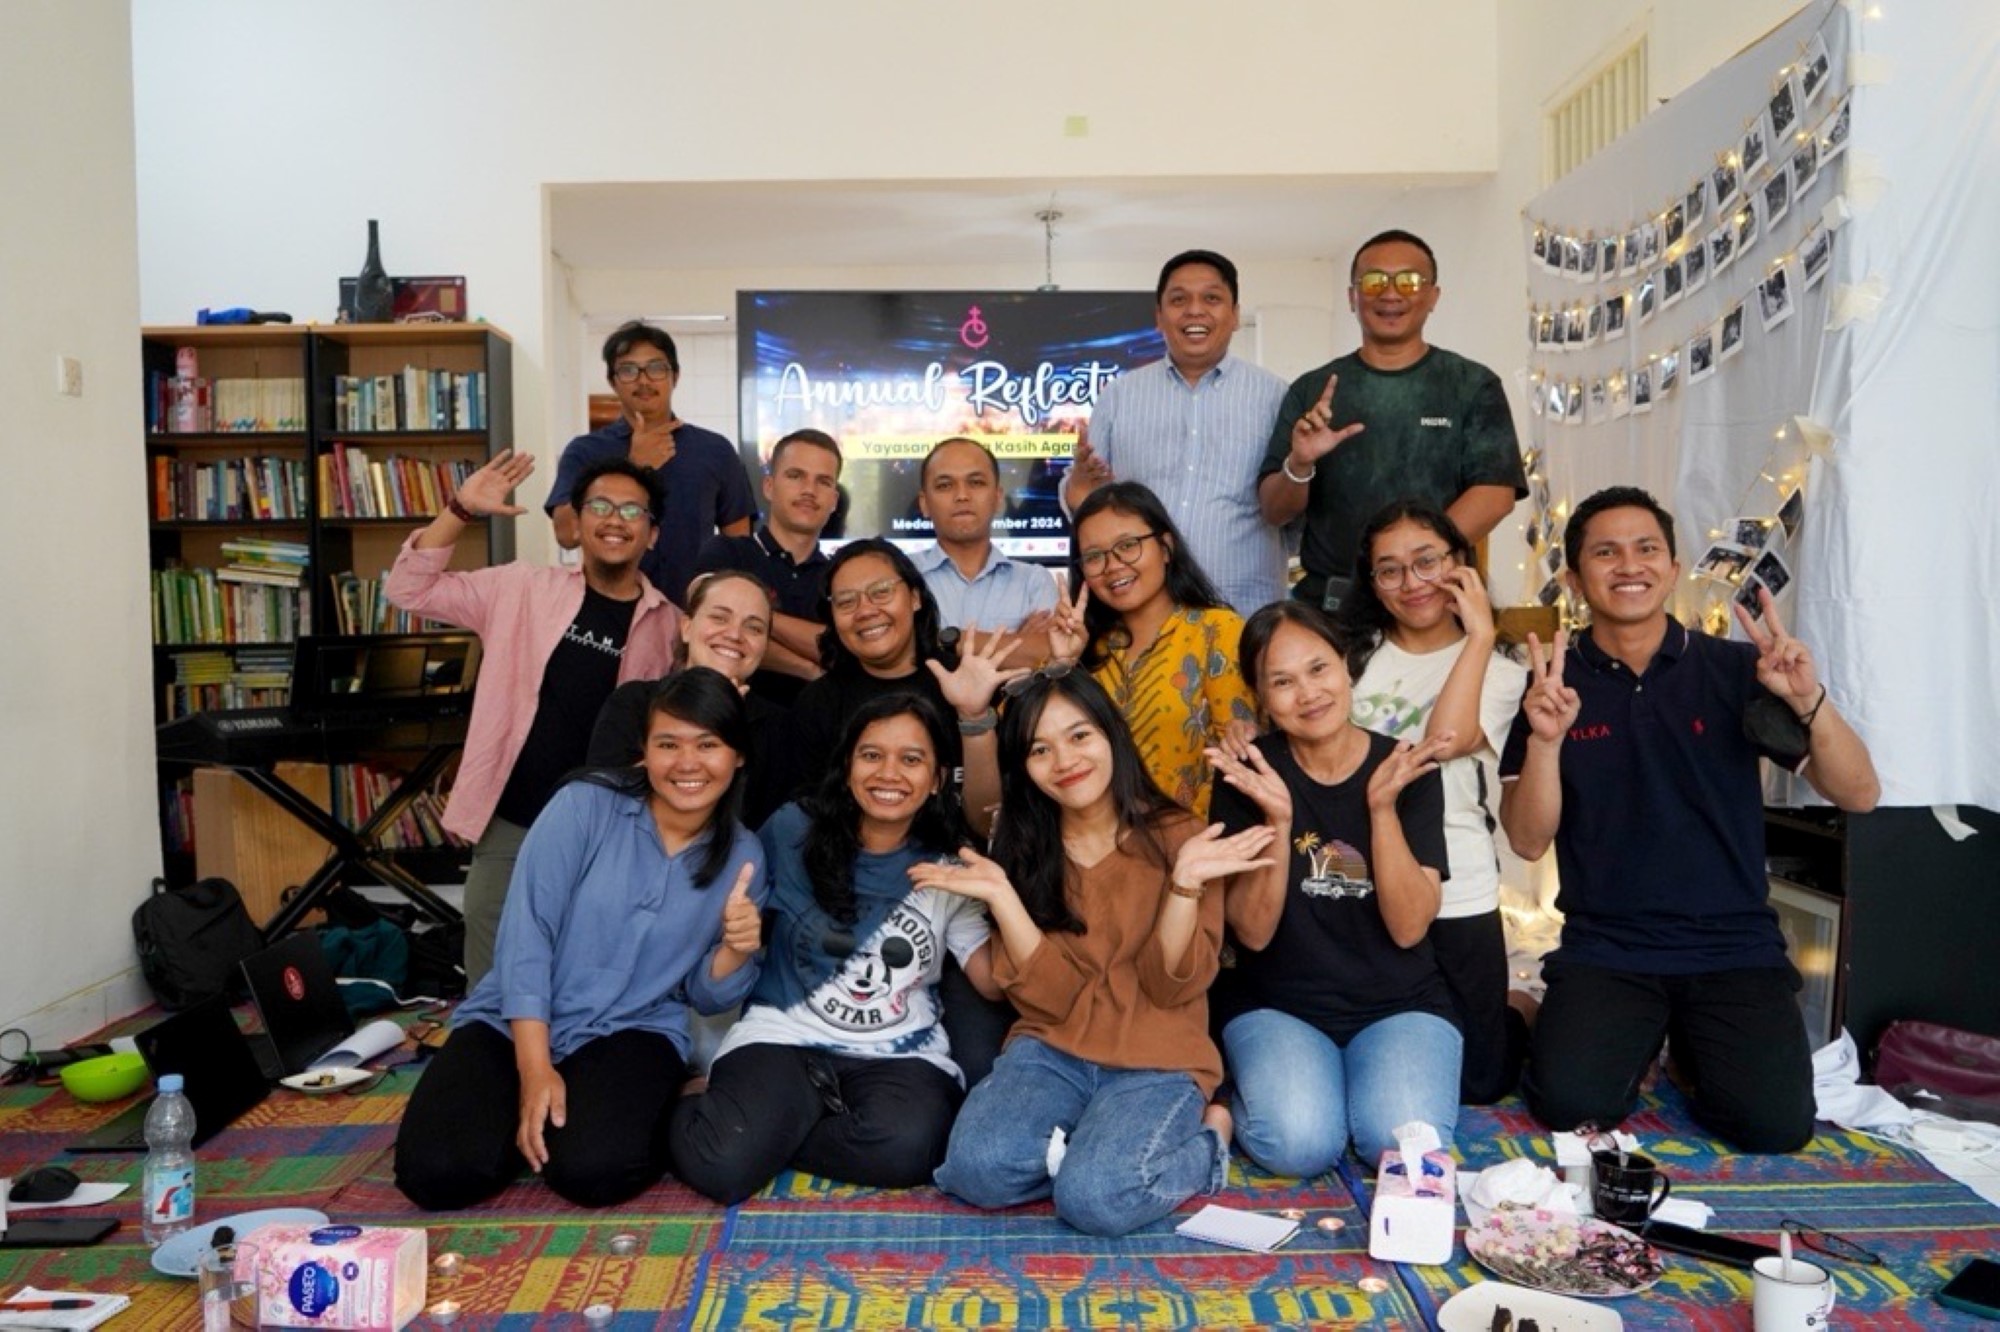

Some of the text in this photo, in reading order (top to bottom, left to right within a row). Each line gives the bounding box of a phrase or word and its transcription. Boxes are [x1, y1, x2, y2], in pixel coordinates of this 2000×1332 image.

[775, 360, 1119, 425] Annual Reflect
[862, 440, 931, 455] Yayasan
[995, 439, 1037, 453] Kasih
[1030, 516, 1063, 530] 2024
[232, 717, 284, 731] YAMAHA
[1569, 724, 1611, 741] YLKA
[823, 997, 883, 1025] STAR
[301, 1266, 317, 1313] PASEO
